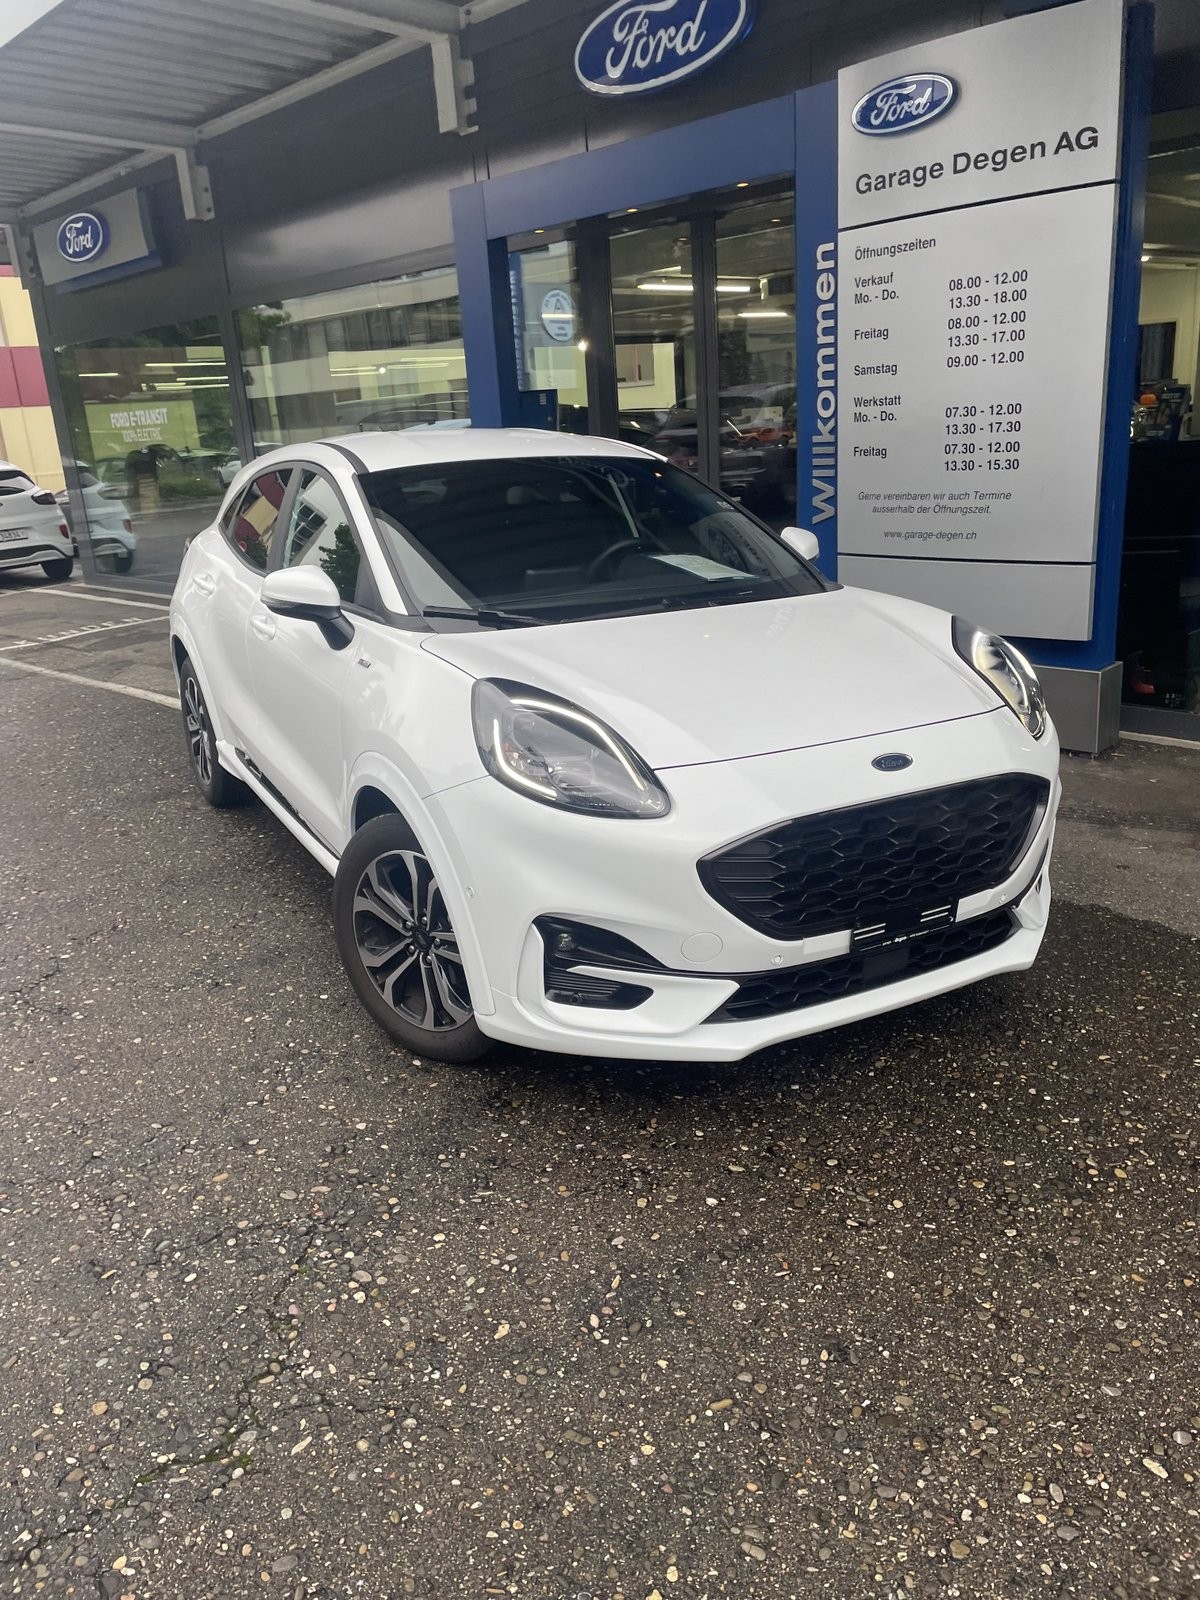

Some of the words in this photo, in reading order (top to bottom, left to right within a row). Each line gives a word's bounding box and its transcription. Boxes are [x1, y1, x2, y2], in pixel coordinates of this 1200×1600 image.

[605, 0, 707, 78] Ford
[870, 83, 932, 126] Ford
[855, 161, 945, 195] Garage
[953, 140, 1046, 175] Degen
[1053, 126, 1100, 155] AG
[66, 221, 93, 254] Ford
[855, 236, 937, 261] Öffnungszeiten
[854, 272, 894, 288] Verkauf
[948, 275, 982, 291] 08.00
[994, 269, 1029, 286] 12.00
[854, 292, 873, 305] Mo.
[881, 289, 900, 301] Do.
[949, 294, 981, 309] 13.30
[993, 288, 1028, 304] 18.00
[947, 315, 980, 330] 08.00
[991, 310, 1027, 325] 12.00
[854, 327, 889, 341] Freitag
[947, 333, 980, 348] 13.30
[991, 329, 1026, 344] 17.00
[946, 355, 979, 369] 09.00
[990, 350, 1025, 365] 12.00
[853, 362, 898, 377] Samstag
[811, 242, 835, 524] Willkommen
[853, 395, 901, 408] Werkstatt
[110, 411, 130, 428] FORD
[129, 407, 168, 426] E-TRANSIT
[853, 412, 871, 423] Mo.
[880, 410, 898, 422] Do.
[945, 406, 977, 419] 07.30
[988, 402, 1022, 416] 12.00
[945, 423, 976, 436] 13.30
[988, 420, 1022, 434] 17.30
[853, 446, 887, 459] Freitag
[944, 443, 976, 455] 07.30
[987, 441, 1021, 453] 12.00
[944, 460, 975, 472] 13.30
[986, 459, 1020, 471] 15.30
[858, 491, 881, 501] Gerne
[883, 491, 931, 501] vereinbaren
[933, 491, 946, 500] wir
[948, 491, 970, 500] auch
[973, 490, 1012, 500] Termine
[872, 504, 915, 514] ausserhalb
[916, 504, 931, 514] der
[933, 503, 992, 516] Öffnungszeit.
[883, 530, 977, 542] www.garage-degen.ch
